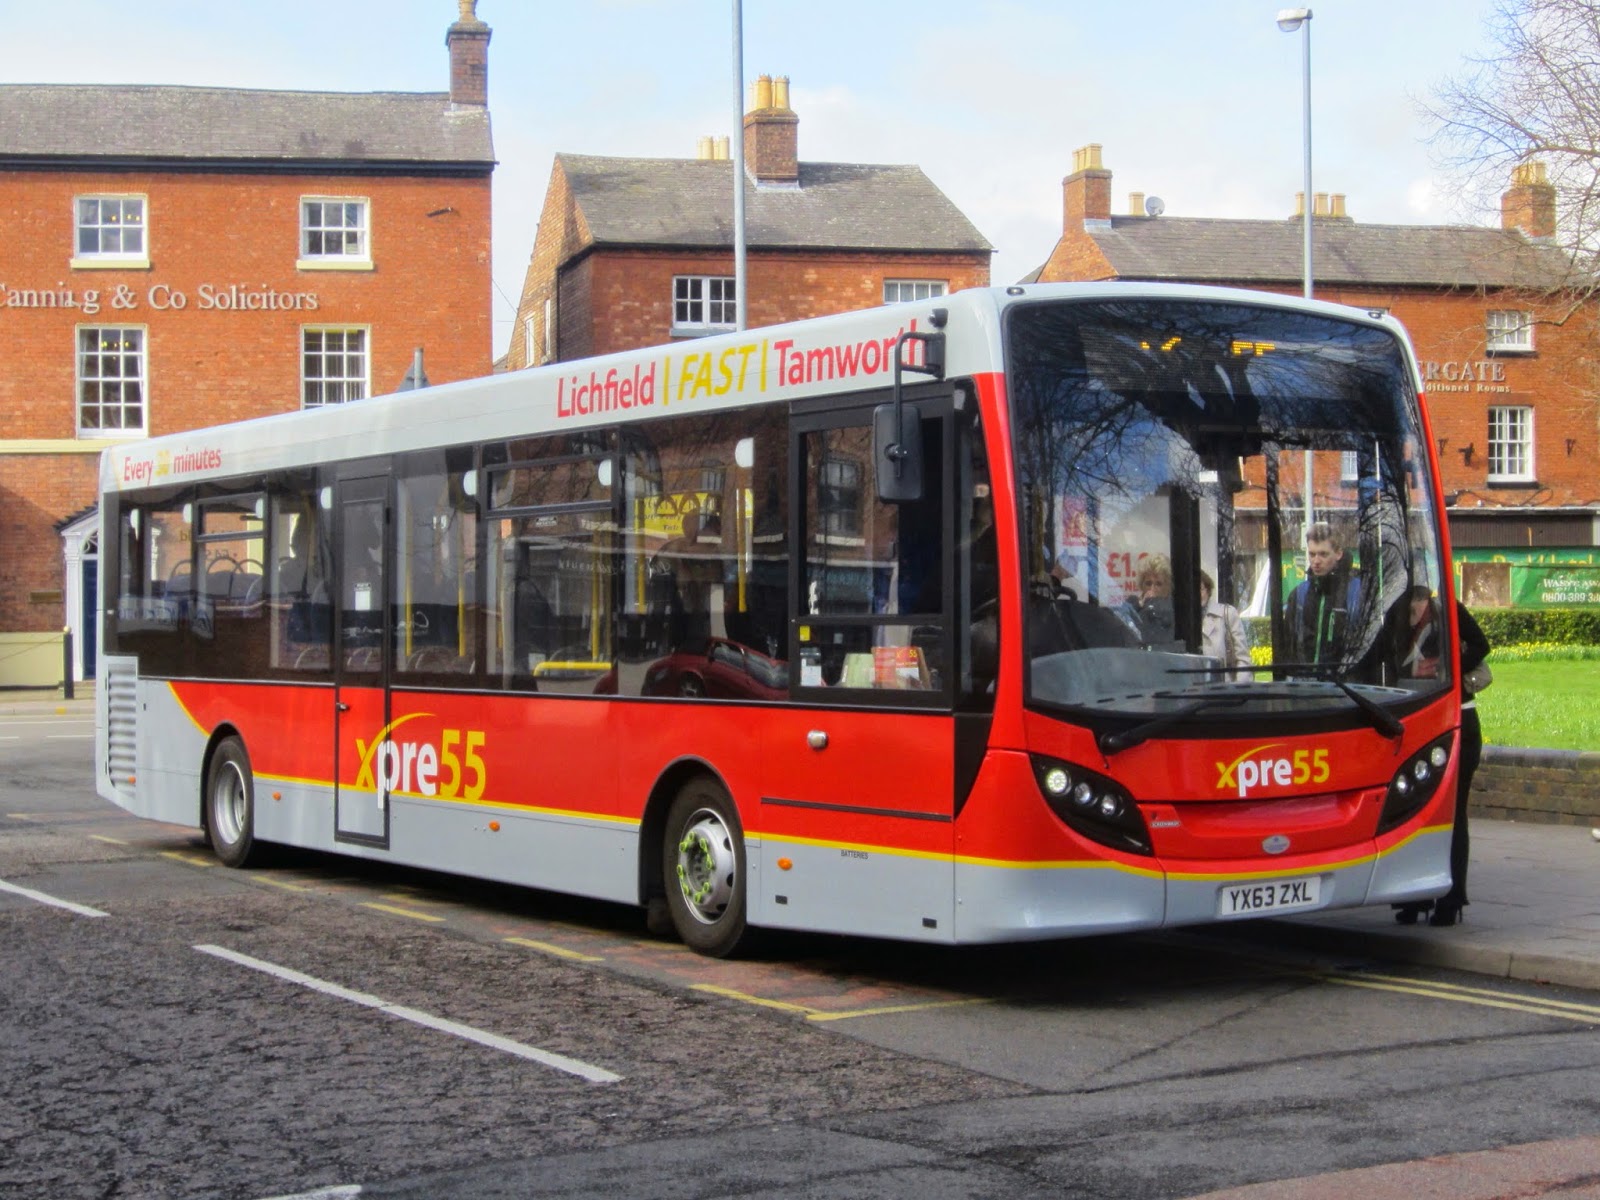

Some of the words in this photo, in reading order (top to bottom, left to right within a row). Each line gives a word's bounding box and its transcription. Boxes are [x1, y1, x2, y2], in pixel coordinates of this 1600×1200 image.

[111, 284, 138, 310] &
[149, 285, 187, 310] Co
[198, 283, 319, 311] Solicitors
[557, 361, 656, 418] Lichfield
[677, 344, 757, 400] FAST
[1424, 383, 1470, 392] ditioned
[1477, 384, 1511, 393] Rooms
[124, 456, 153, 487] Every
[173, 446, 222, 474] minutes
[355, 714, 487, 809] xpre55
[1216, 745, 1330, 797] xpre55
[1230, 886, 1275, 911] YX63
[1280, 881, 1312, 905] ZXL
